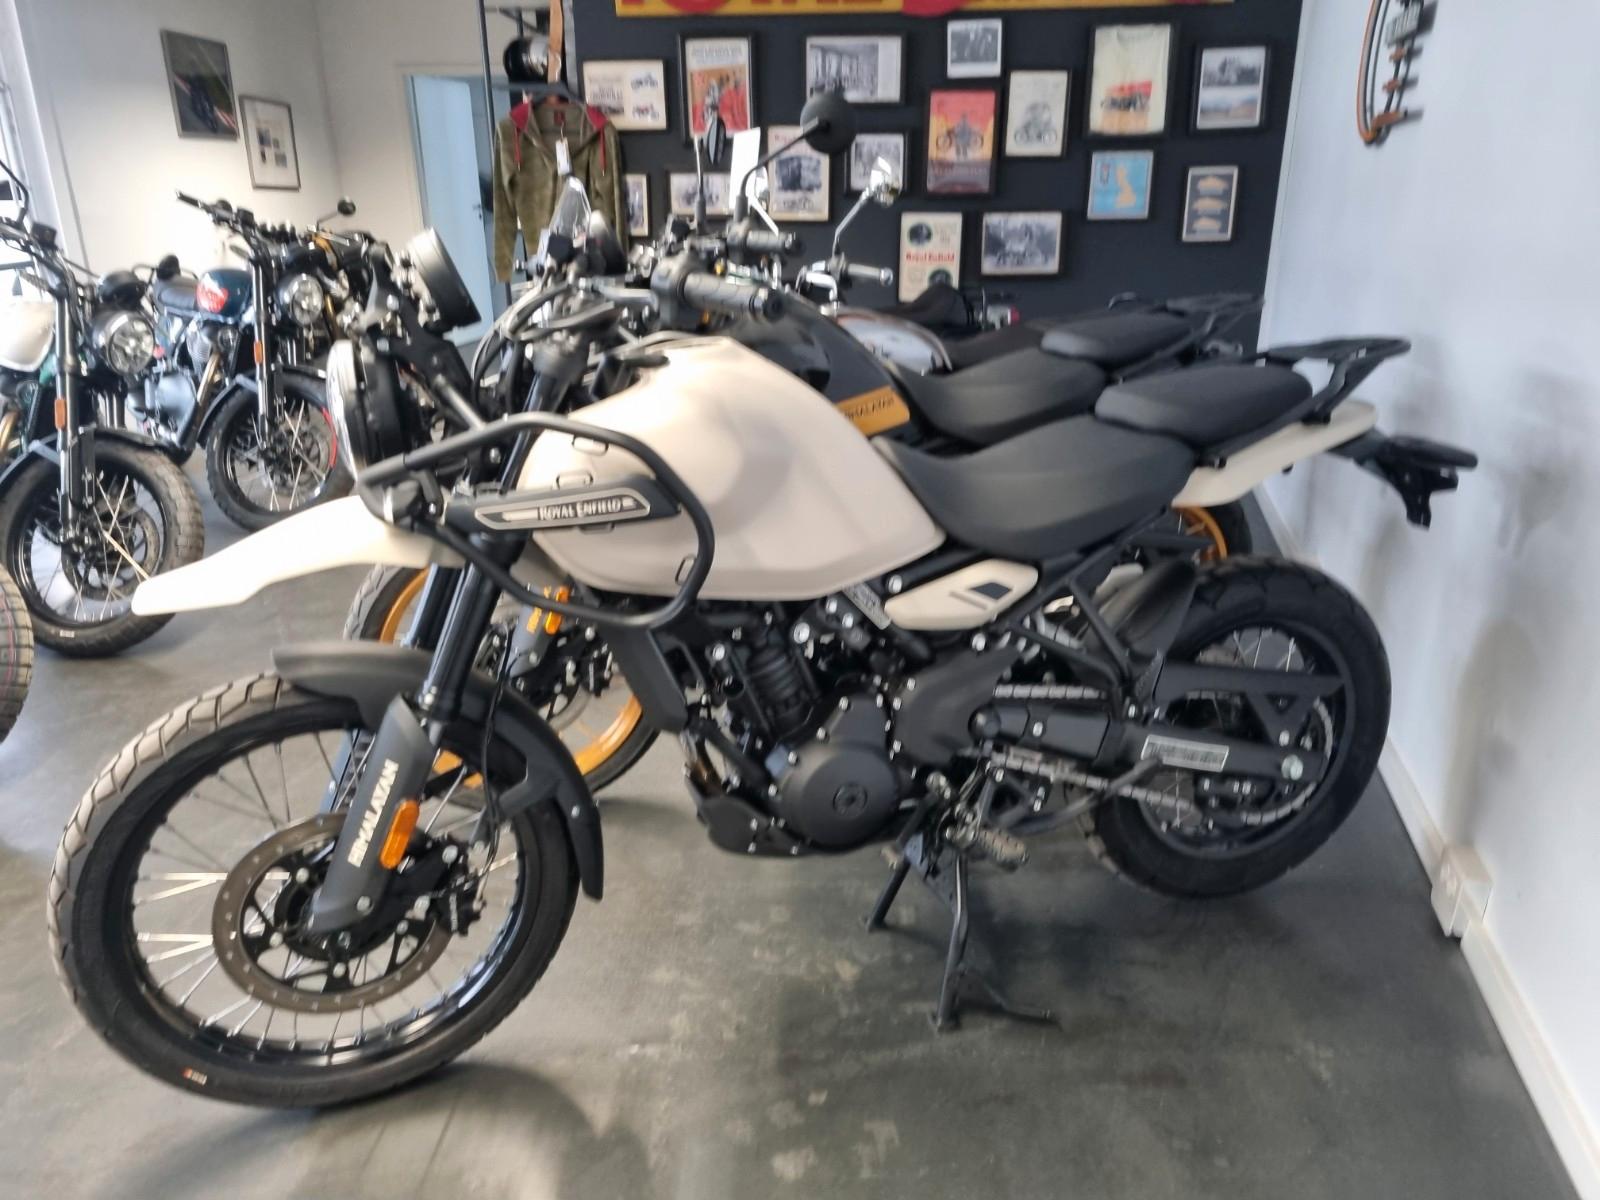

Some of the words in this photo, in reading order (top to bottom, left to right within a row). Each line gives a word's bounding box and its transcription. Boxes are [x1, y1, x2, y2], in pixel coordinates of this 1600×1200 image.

[539, 504, 575, 521] ROYAL
[576, 498, 622, 518] ENFIELD
[347, 758, 400, 868] HIMALAYAN
